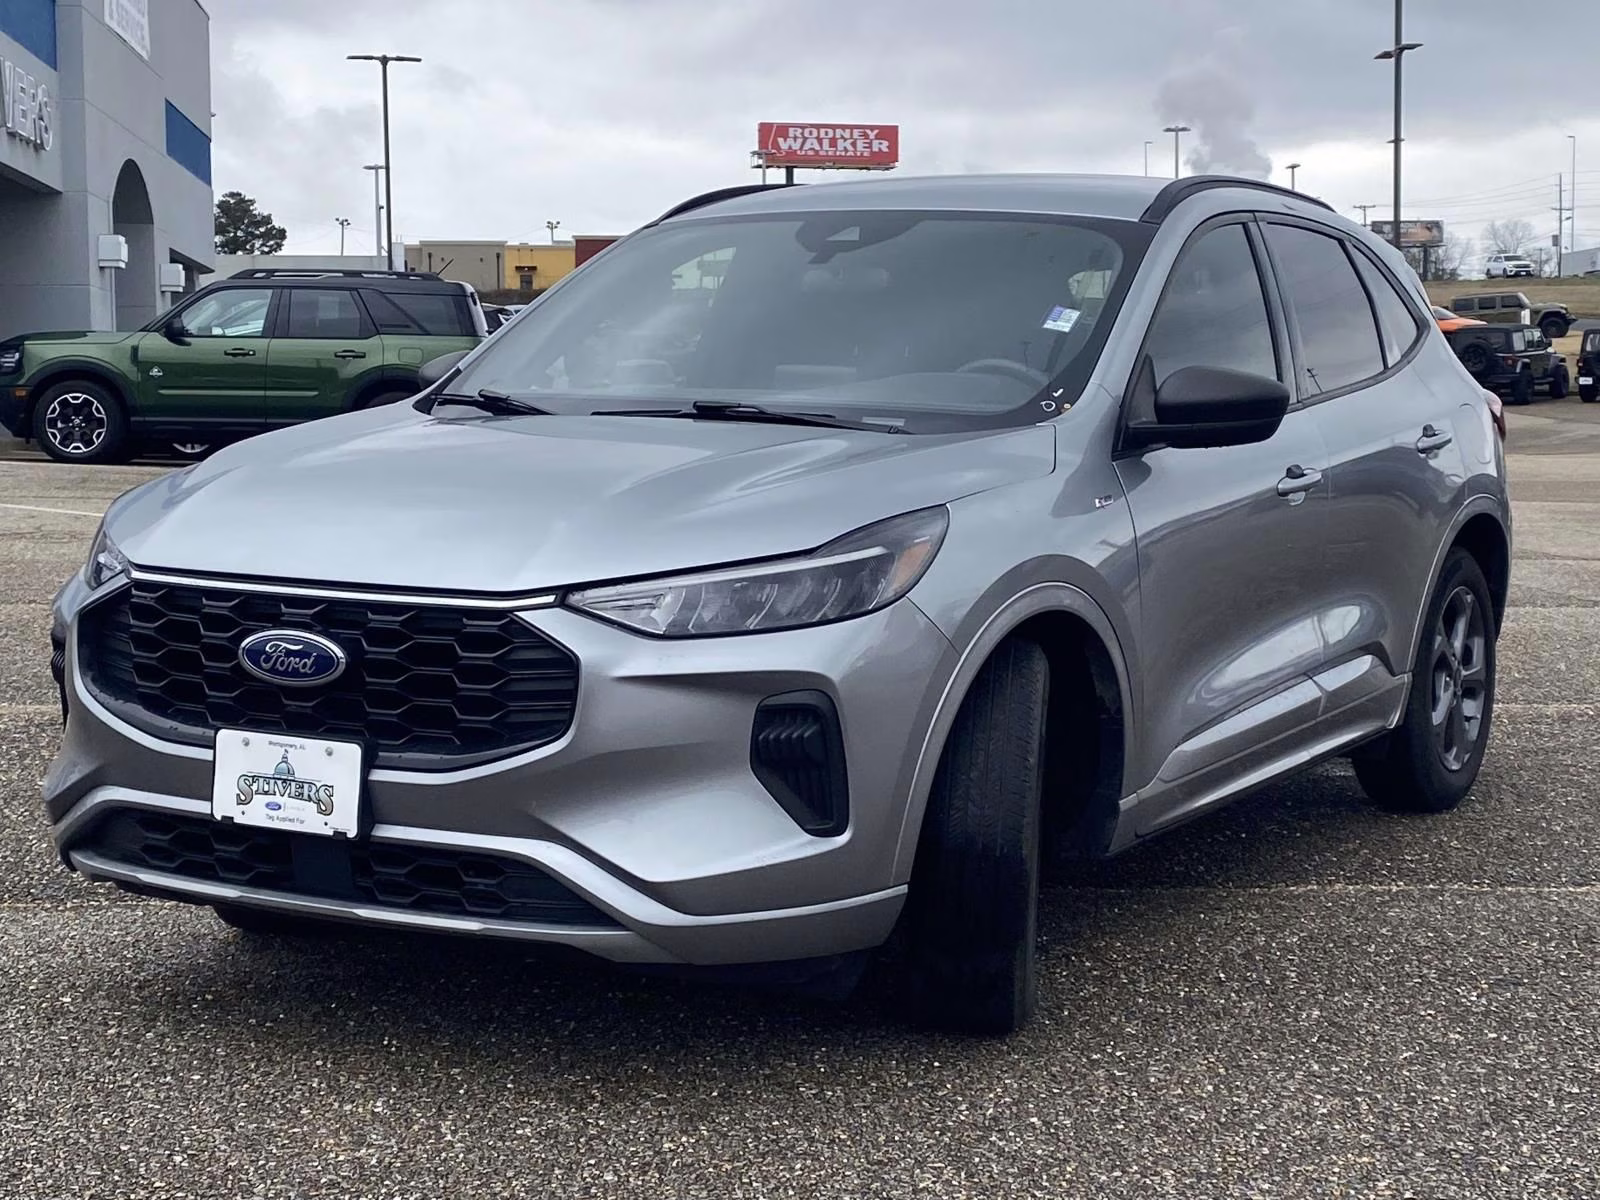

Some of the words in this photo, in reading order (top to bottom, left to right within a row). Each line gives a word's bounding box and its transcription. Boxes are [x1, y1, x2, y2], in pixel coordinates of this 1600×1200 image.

[788, 127, 880, 139] RODNEY
[777, 137, 889, 152] WALKER
[260, 641, 318, 674] Ford
[236, 773, 334, 816] STIVERS
[266, 814, 275, 822] Tag
[276, 815, 295, 824] Applied
